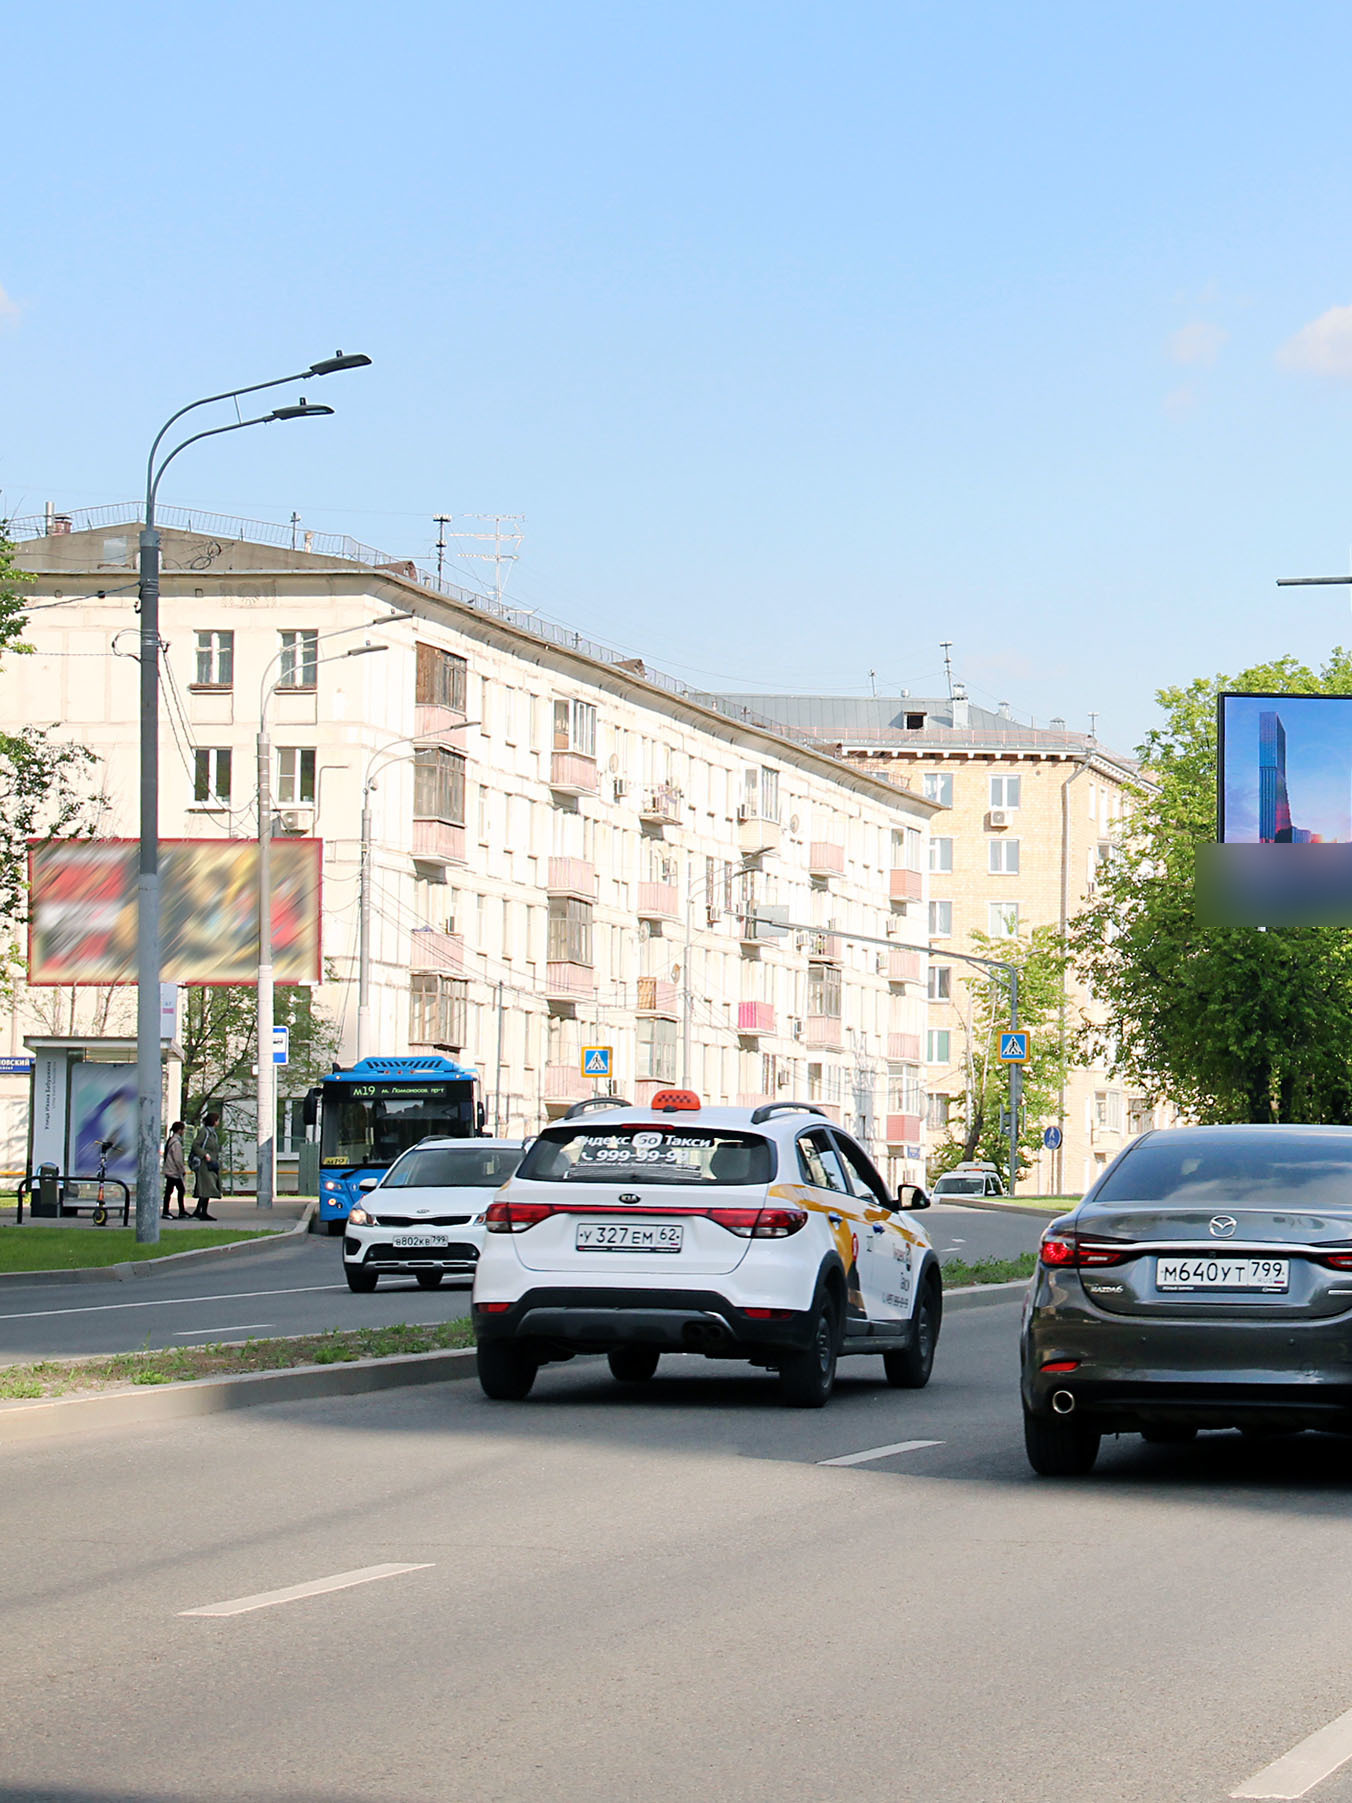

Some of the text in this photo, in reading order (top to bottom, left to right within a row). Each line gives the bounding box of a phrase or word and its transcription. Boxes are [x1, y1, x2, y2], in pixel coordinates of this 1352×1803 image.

[0, 1058, 30, 1066] ОВСКИЙ
[664, 1134, 712, 1147] Такси
[596, 1149, 689, 1162] 999-99-99
[659, 1228, 677, 1241] 62
[1251, 1261, 1283, 1278] 799
